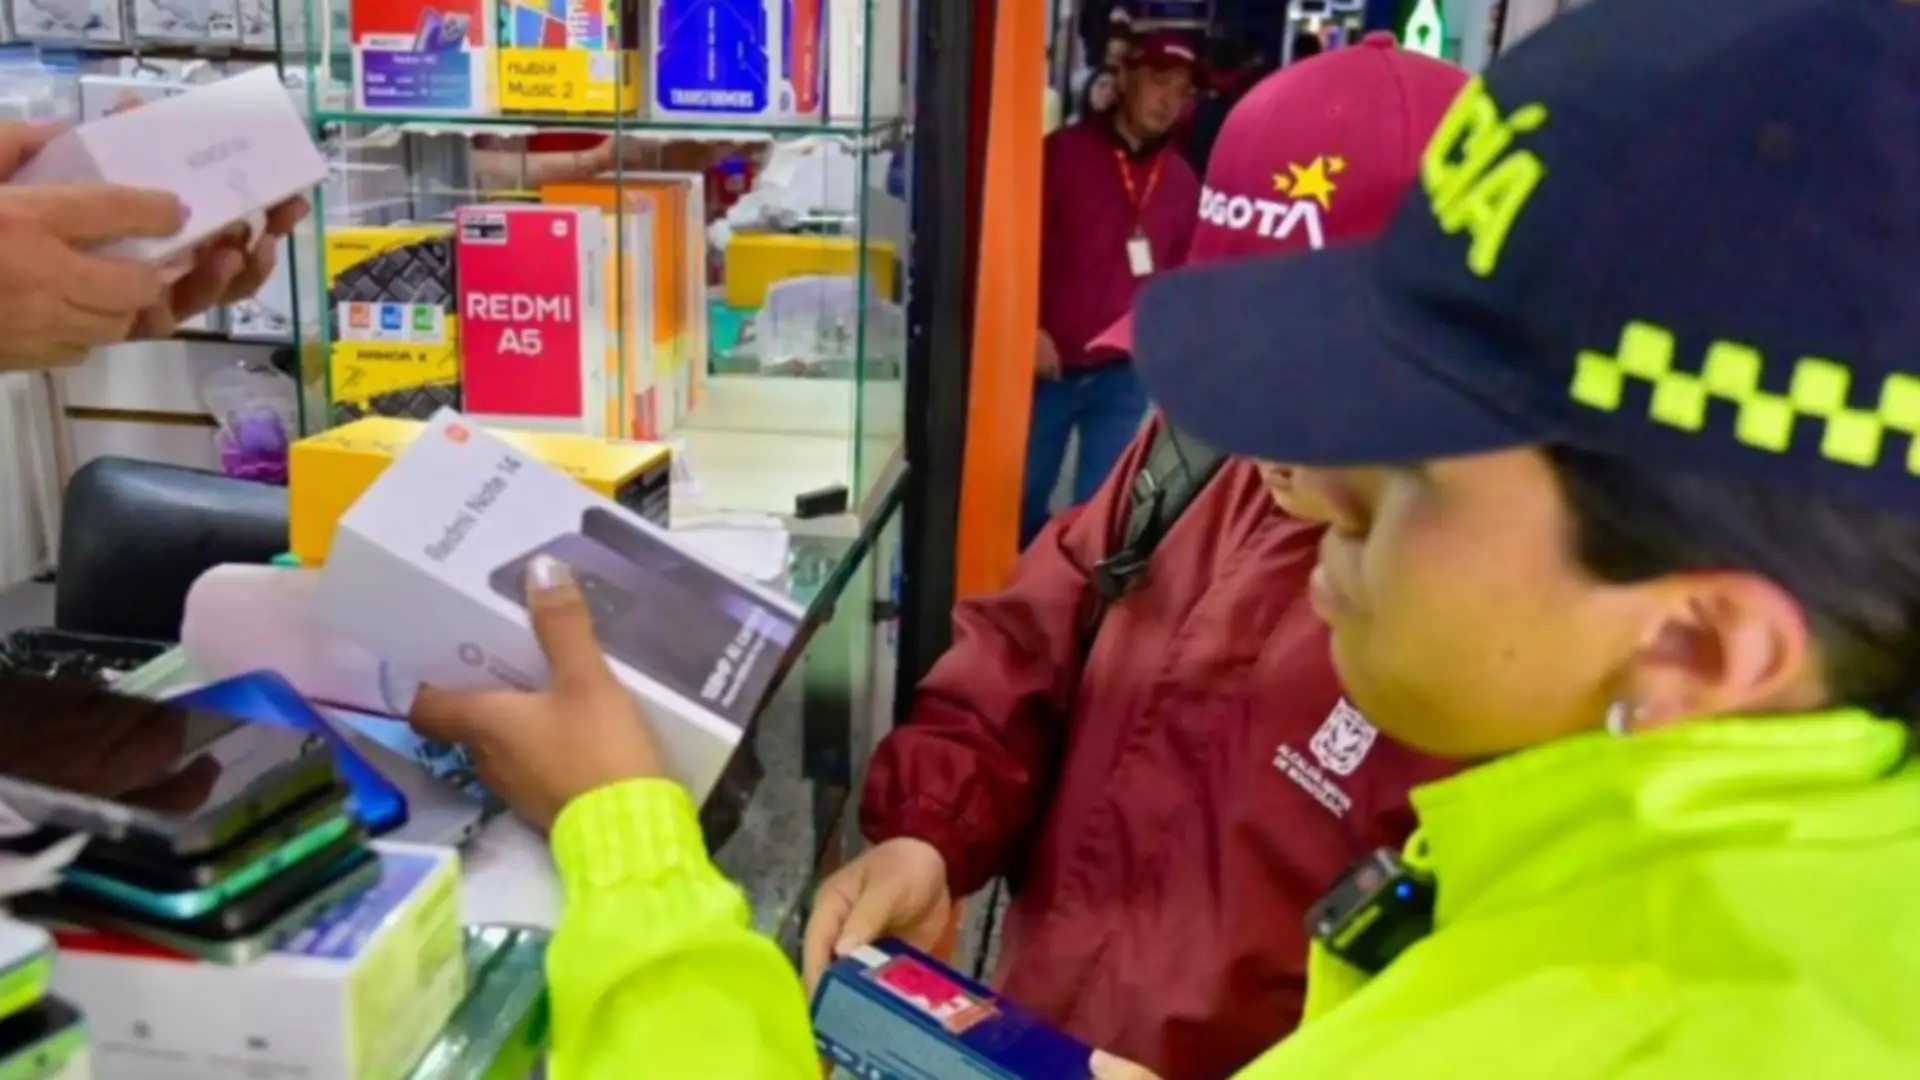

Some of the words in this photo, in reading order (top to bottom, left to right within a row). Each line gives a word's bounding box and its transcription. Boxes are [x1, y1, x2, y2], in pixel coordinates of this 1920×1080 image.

[507, 60, 558, 75] nubia
[507, 80, 557, 97] Music
[562, 80, 574, 99] 2
[670, 88, 754, 107] TRANSFORMERS
[466, 292, 572, 322] REDMI
[497, 327, 544, 356] A5
[356, 349, 412, 363] ARMOR
[423, 509, 477, 562] Redmi
[463, 474, 508, 515] Note
[496, 455, 523, 475] 14
